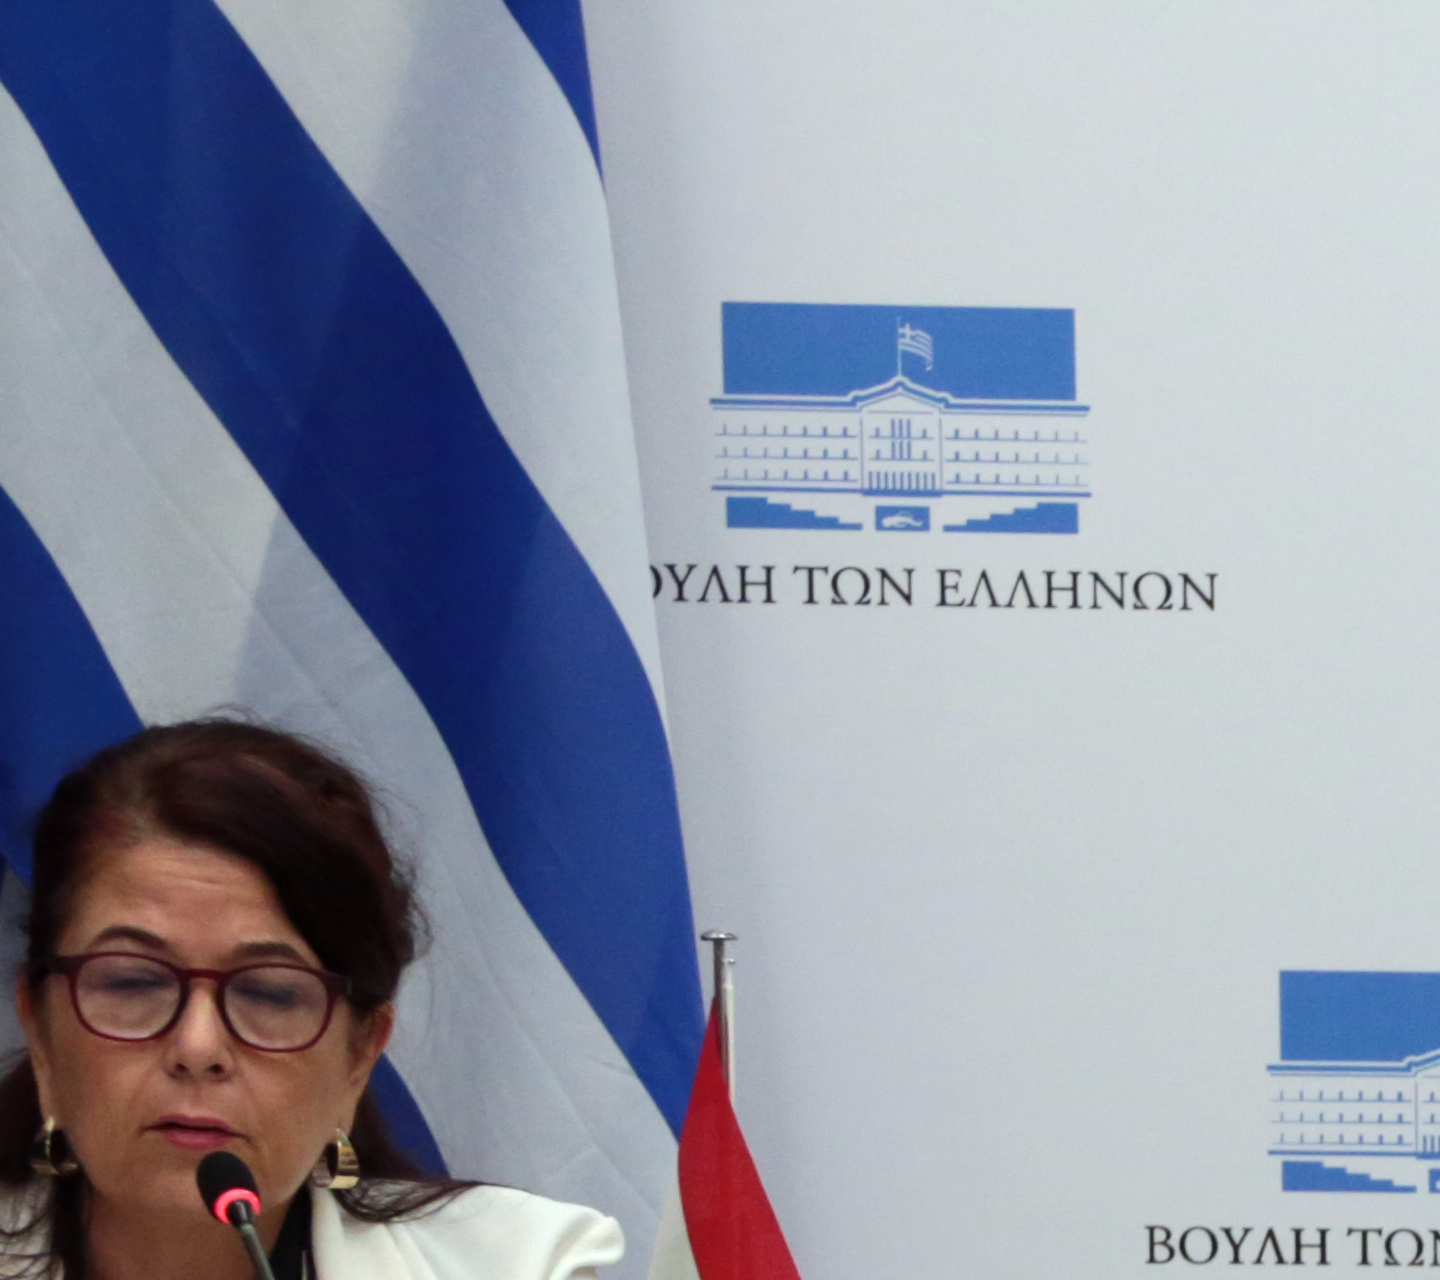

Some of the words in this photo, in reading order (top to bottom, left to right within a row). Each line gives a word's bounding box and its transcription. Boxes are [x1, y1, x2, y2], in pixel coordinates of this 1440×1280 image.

[648, 562, 776, 605] ΥΛΗ
[791, 564, 915, 607] ΤΩΝ
[936, 568, 1218, 612] ΕΛΛΗΝΩΝ
[1145, 1224, 1330, 1267] ΒΟΥΛΗ
